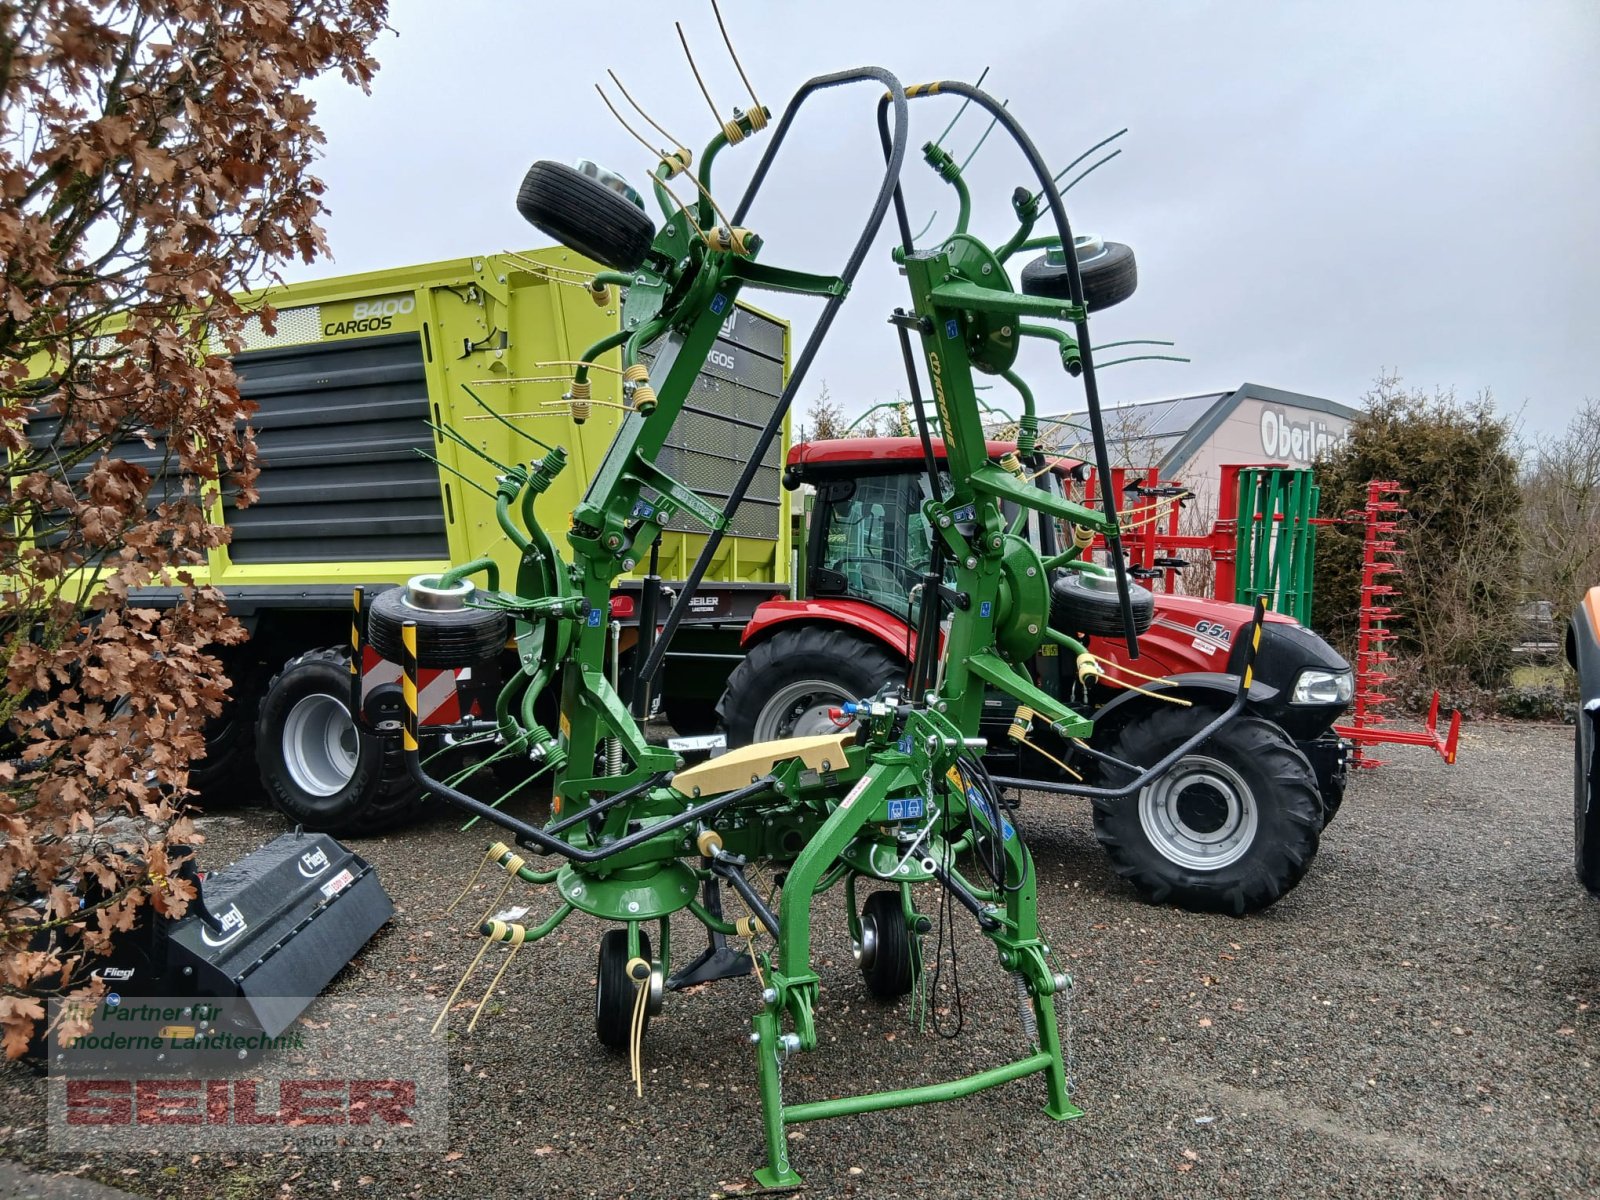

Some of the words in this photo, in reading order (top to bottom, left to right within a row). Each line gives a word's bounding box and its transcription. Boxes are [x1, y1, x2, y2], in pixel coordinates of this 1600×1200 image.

[353, 296, 415, 320] 8400
[324, 316, 392, 336] CARGOS
[933, 374, 956, 449] KRONE
[1194, 620, 1231, 641] 65A
[301, 846, 328, 870] Fliegl
[104, 967, 135, 980] Fliegl
